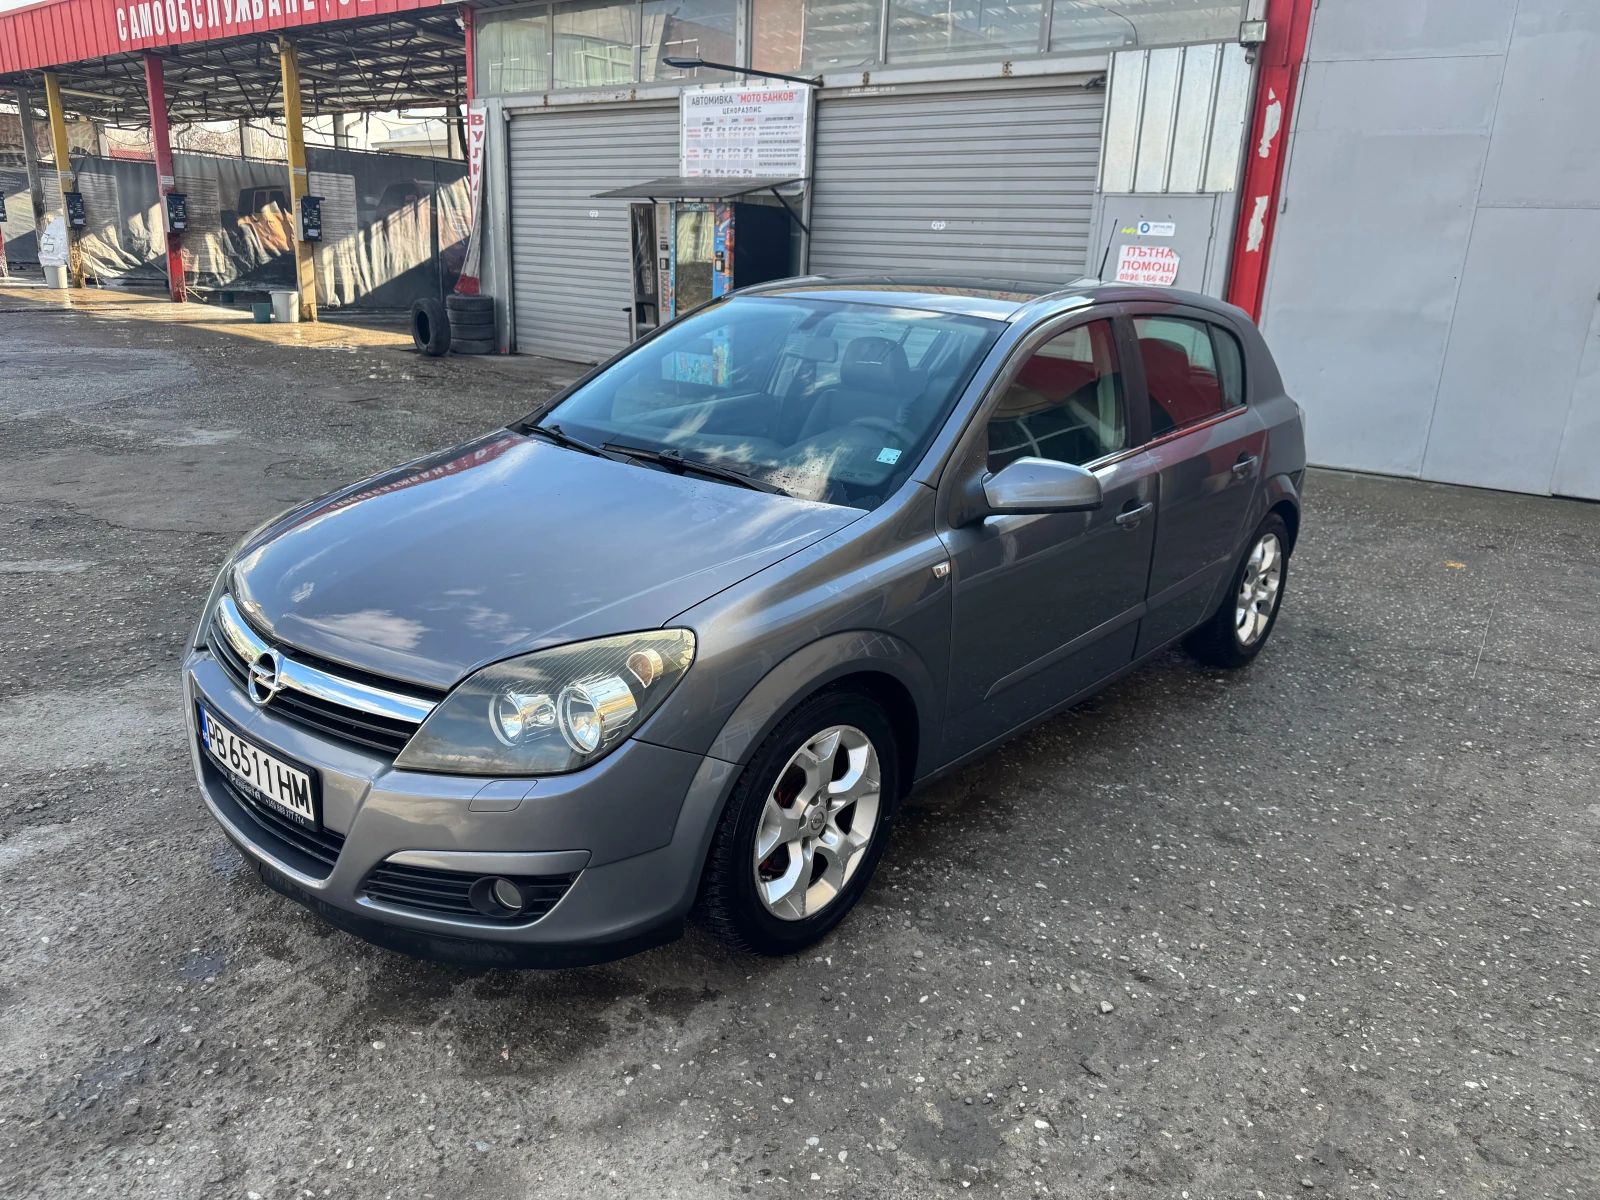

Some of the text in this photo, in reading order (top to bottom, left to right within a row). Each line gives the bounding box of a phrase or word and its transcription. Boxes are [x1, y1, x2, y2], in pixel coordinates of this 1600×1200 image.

[117, 0, 314, 42] САМООБСЛУЖВА
[692, 91, 798, 106] АВТОМИВКА "МОТО БАНКОВ"
[722, 106, 762, 115] ЦЕНОРАЗПИС
[1127, 247, 1174, 258] ПЪТНА
[1122, 261, 1175, 274] ПОМОЩ
